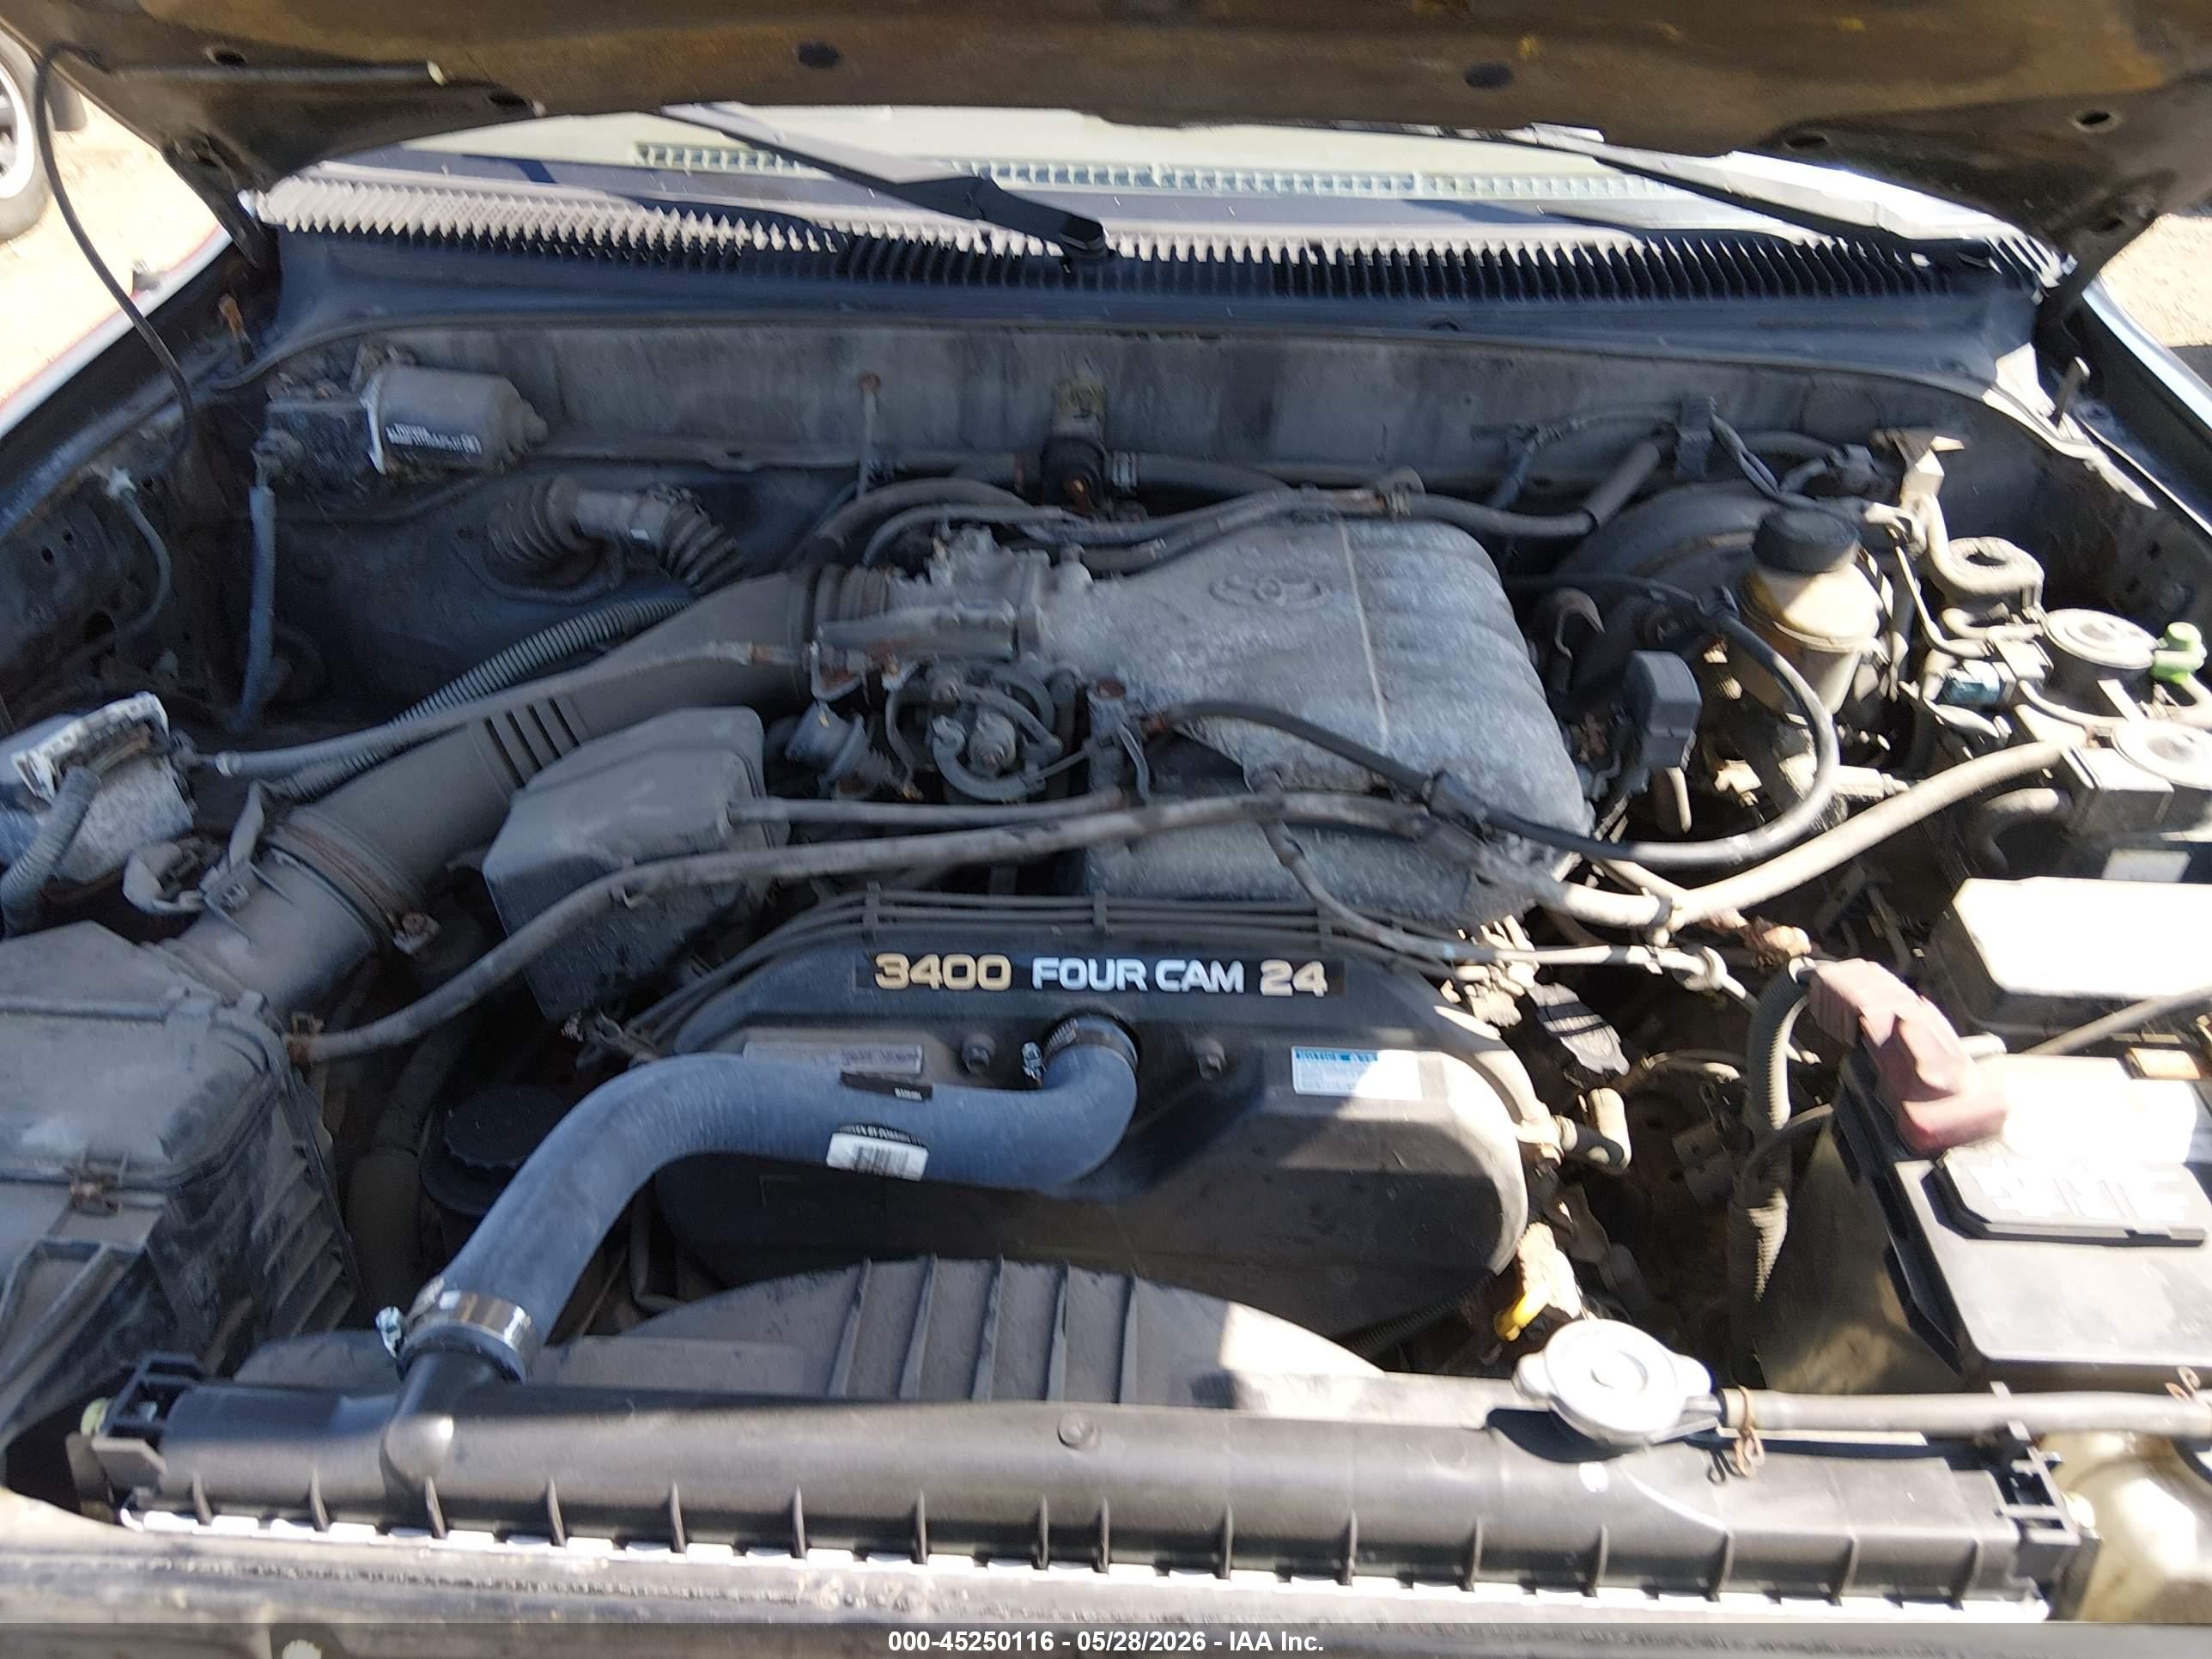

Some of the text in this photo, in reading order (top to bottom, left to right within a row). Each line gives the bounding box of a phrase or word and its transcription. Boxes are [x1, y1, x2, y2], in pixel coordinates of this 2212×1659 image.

[874, 952, 1328, 998] 3400 FOUR CAM 24
